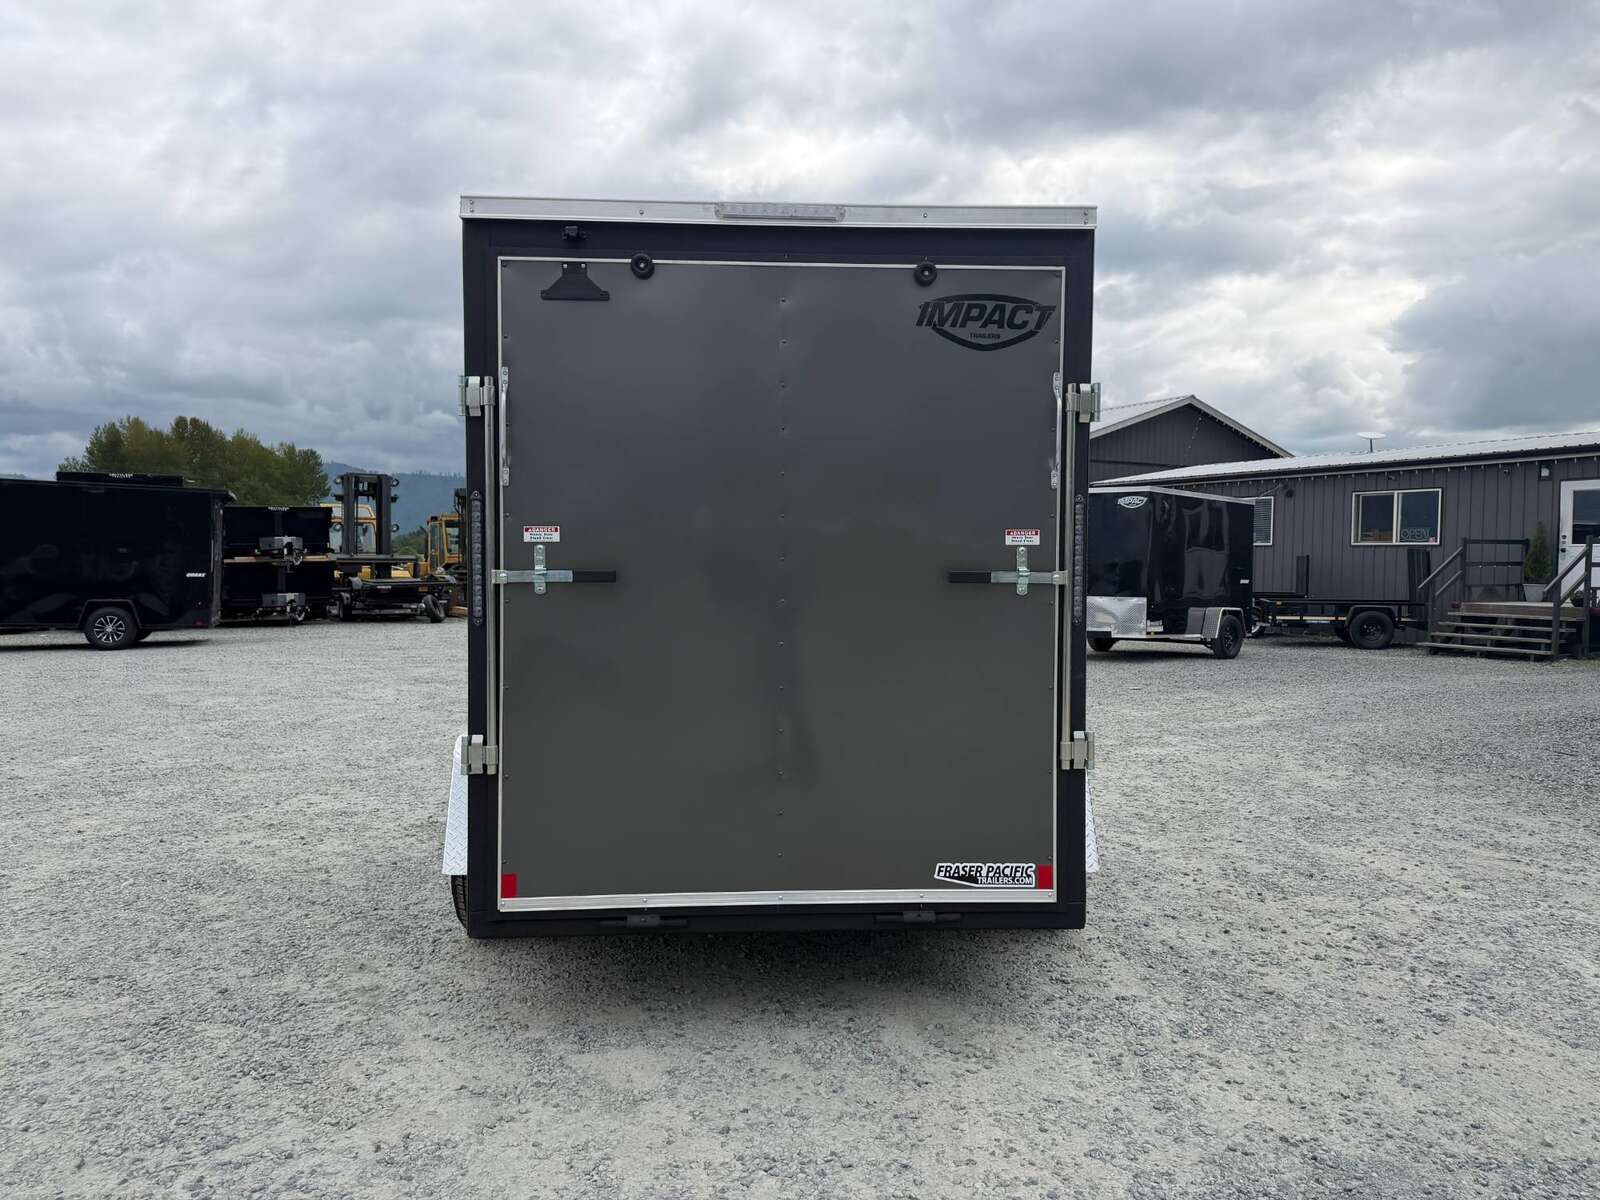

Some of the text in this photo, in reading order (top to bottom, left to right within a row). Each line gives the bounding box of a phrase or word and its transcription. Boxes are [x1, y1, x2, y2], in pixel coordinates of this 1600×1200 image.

[915, 301, 1056, 330] IMPACT
[1401, 528, 1429, 539] OPEN
[936, 865, 1034, 877] FRASER PACIFIC
[977, 877, 1033, 885] TRAILERS.COM
